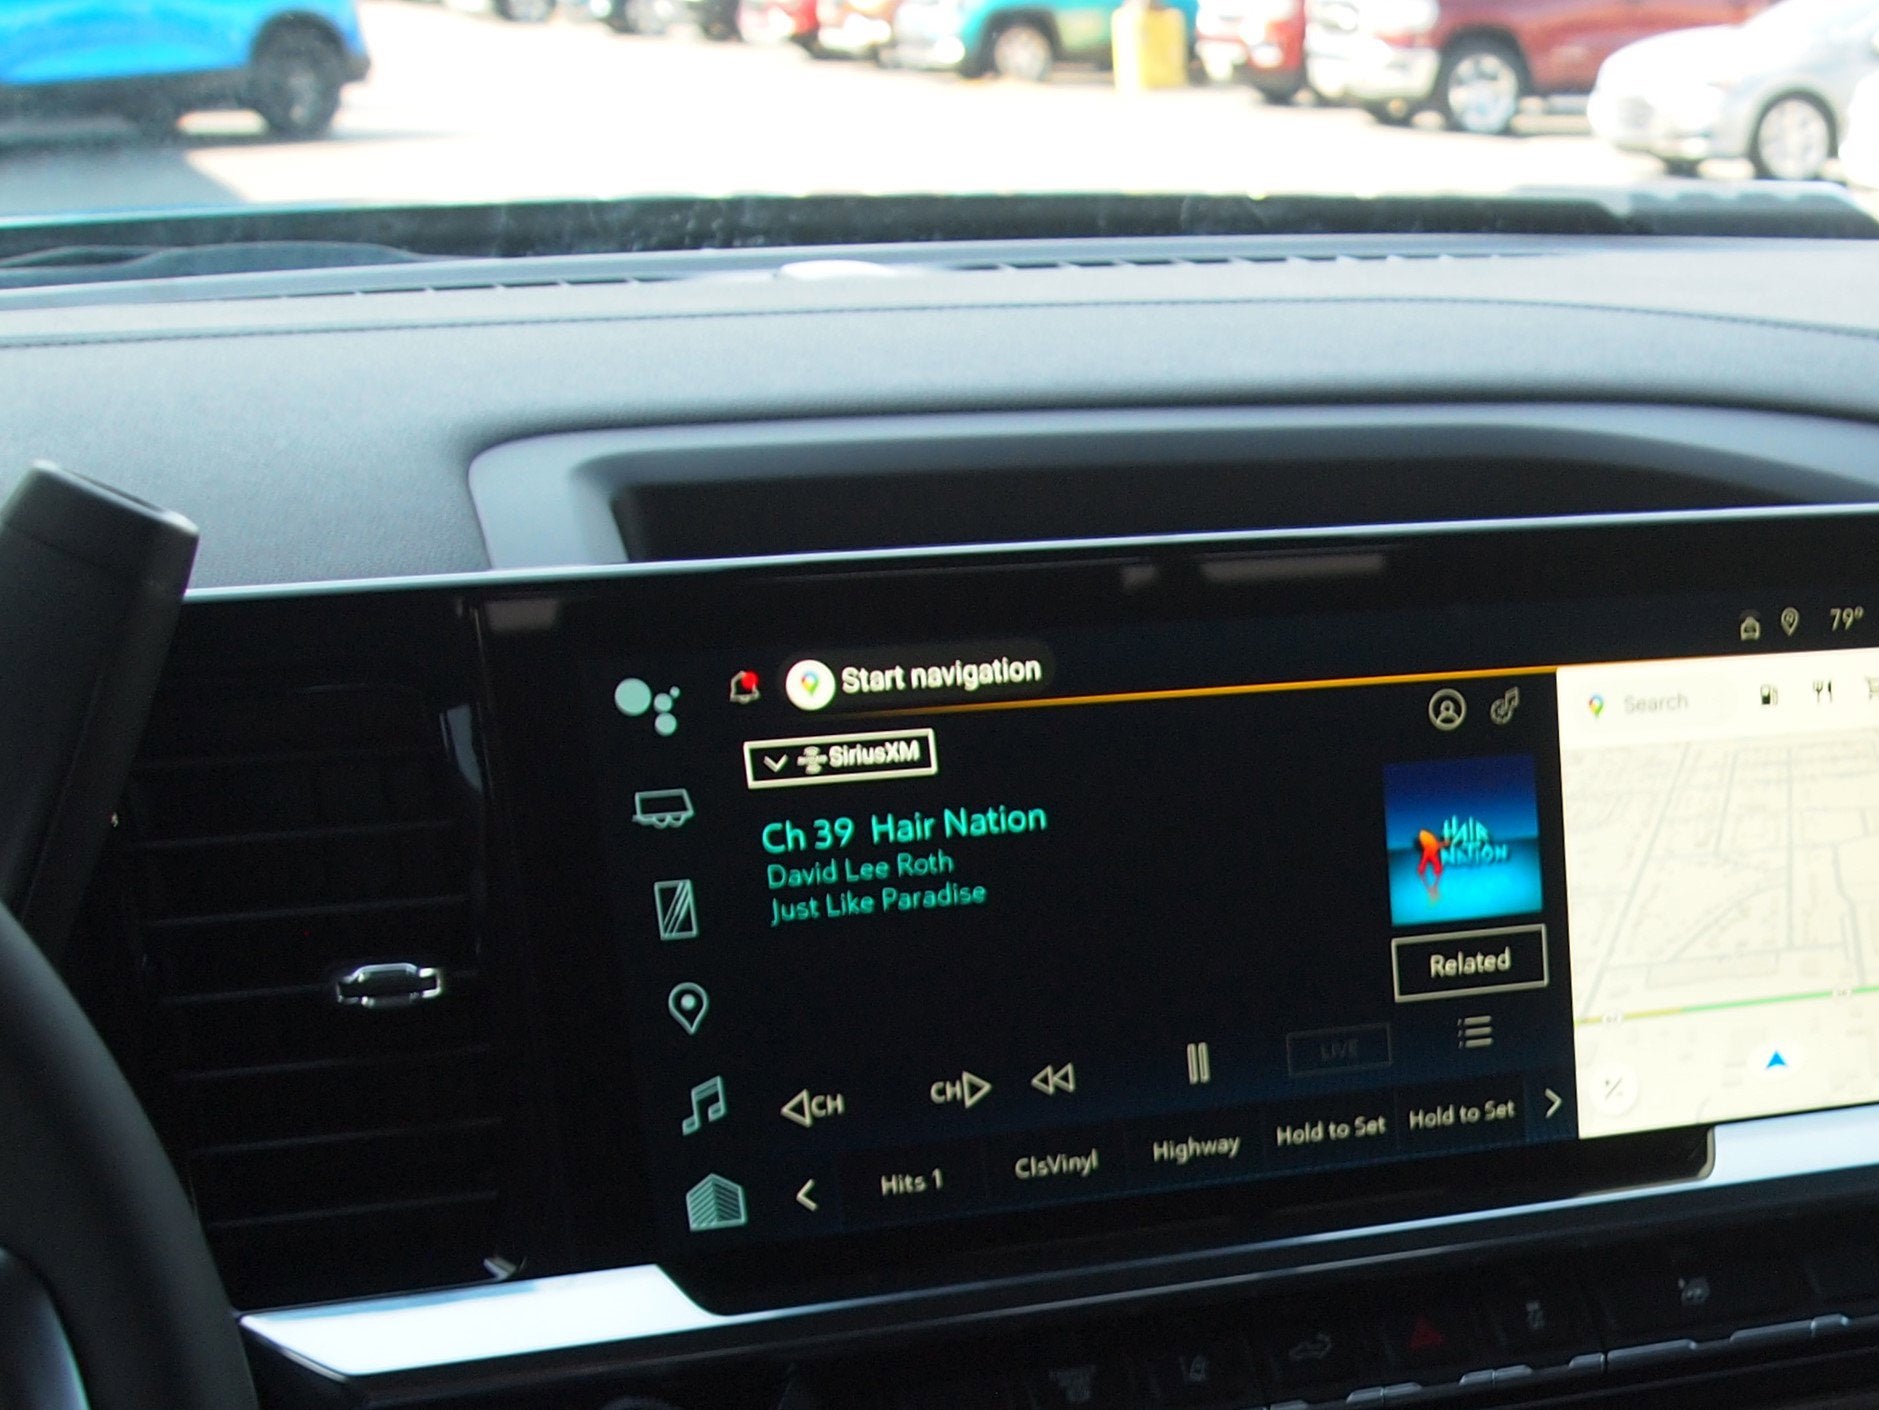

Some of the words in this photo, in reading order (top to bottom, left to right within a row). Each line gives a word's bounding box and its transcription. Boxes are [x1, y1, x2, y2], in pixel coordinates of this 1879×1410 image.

[841, 664, 906, 694] Start
[910, 656, 1042, 692] navigation
[1623, 691, 1690, 714] Search
[828, 739, 921, 769] SiriusXM
[762, 819, 807, 854] Ch
[813, 816, 855, 850] 39
[871, 811, 935, 845] Hair
[943, 804, 1047, 838] Nation
[1442, 814, 1491, 846] HAIR
[767, 857, 838, 890] David
[844, 857, 890, 882] Lee
[897, 848, 955, 878] Roth
[770, 895, 820, 928] Just
[825, 889, 876, 918] Like
[881, 880, 988, 912] Paradise
[1429, 946, 1512, 979] Related
[811, 1092, 845, 1119] CH
[929, 1078, 963, 1105] CH
[1276, 1119, 1323, 1147] Hold
[1328, 1119, 1351, 1142] to
[1354, 1114, 1388, 1139] Set
[1408, 1103, 1455, 1131] Hold
[1459, 1103, 1481, 1125] to
[1484, 1098, 1516, 1121] Set
[1014, 1147, 1099, 1180] ClsVinyl
[1152, 1133, 1242, 1166] Highway
[880, 1172, 927, 1197] Hits
[931, 1167, 944, 1191] 1
